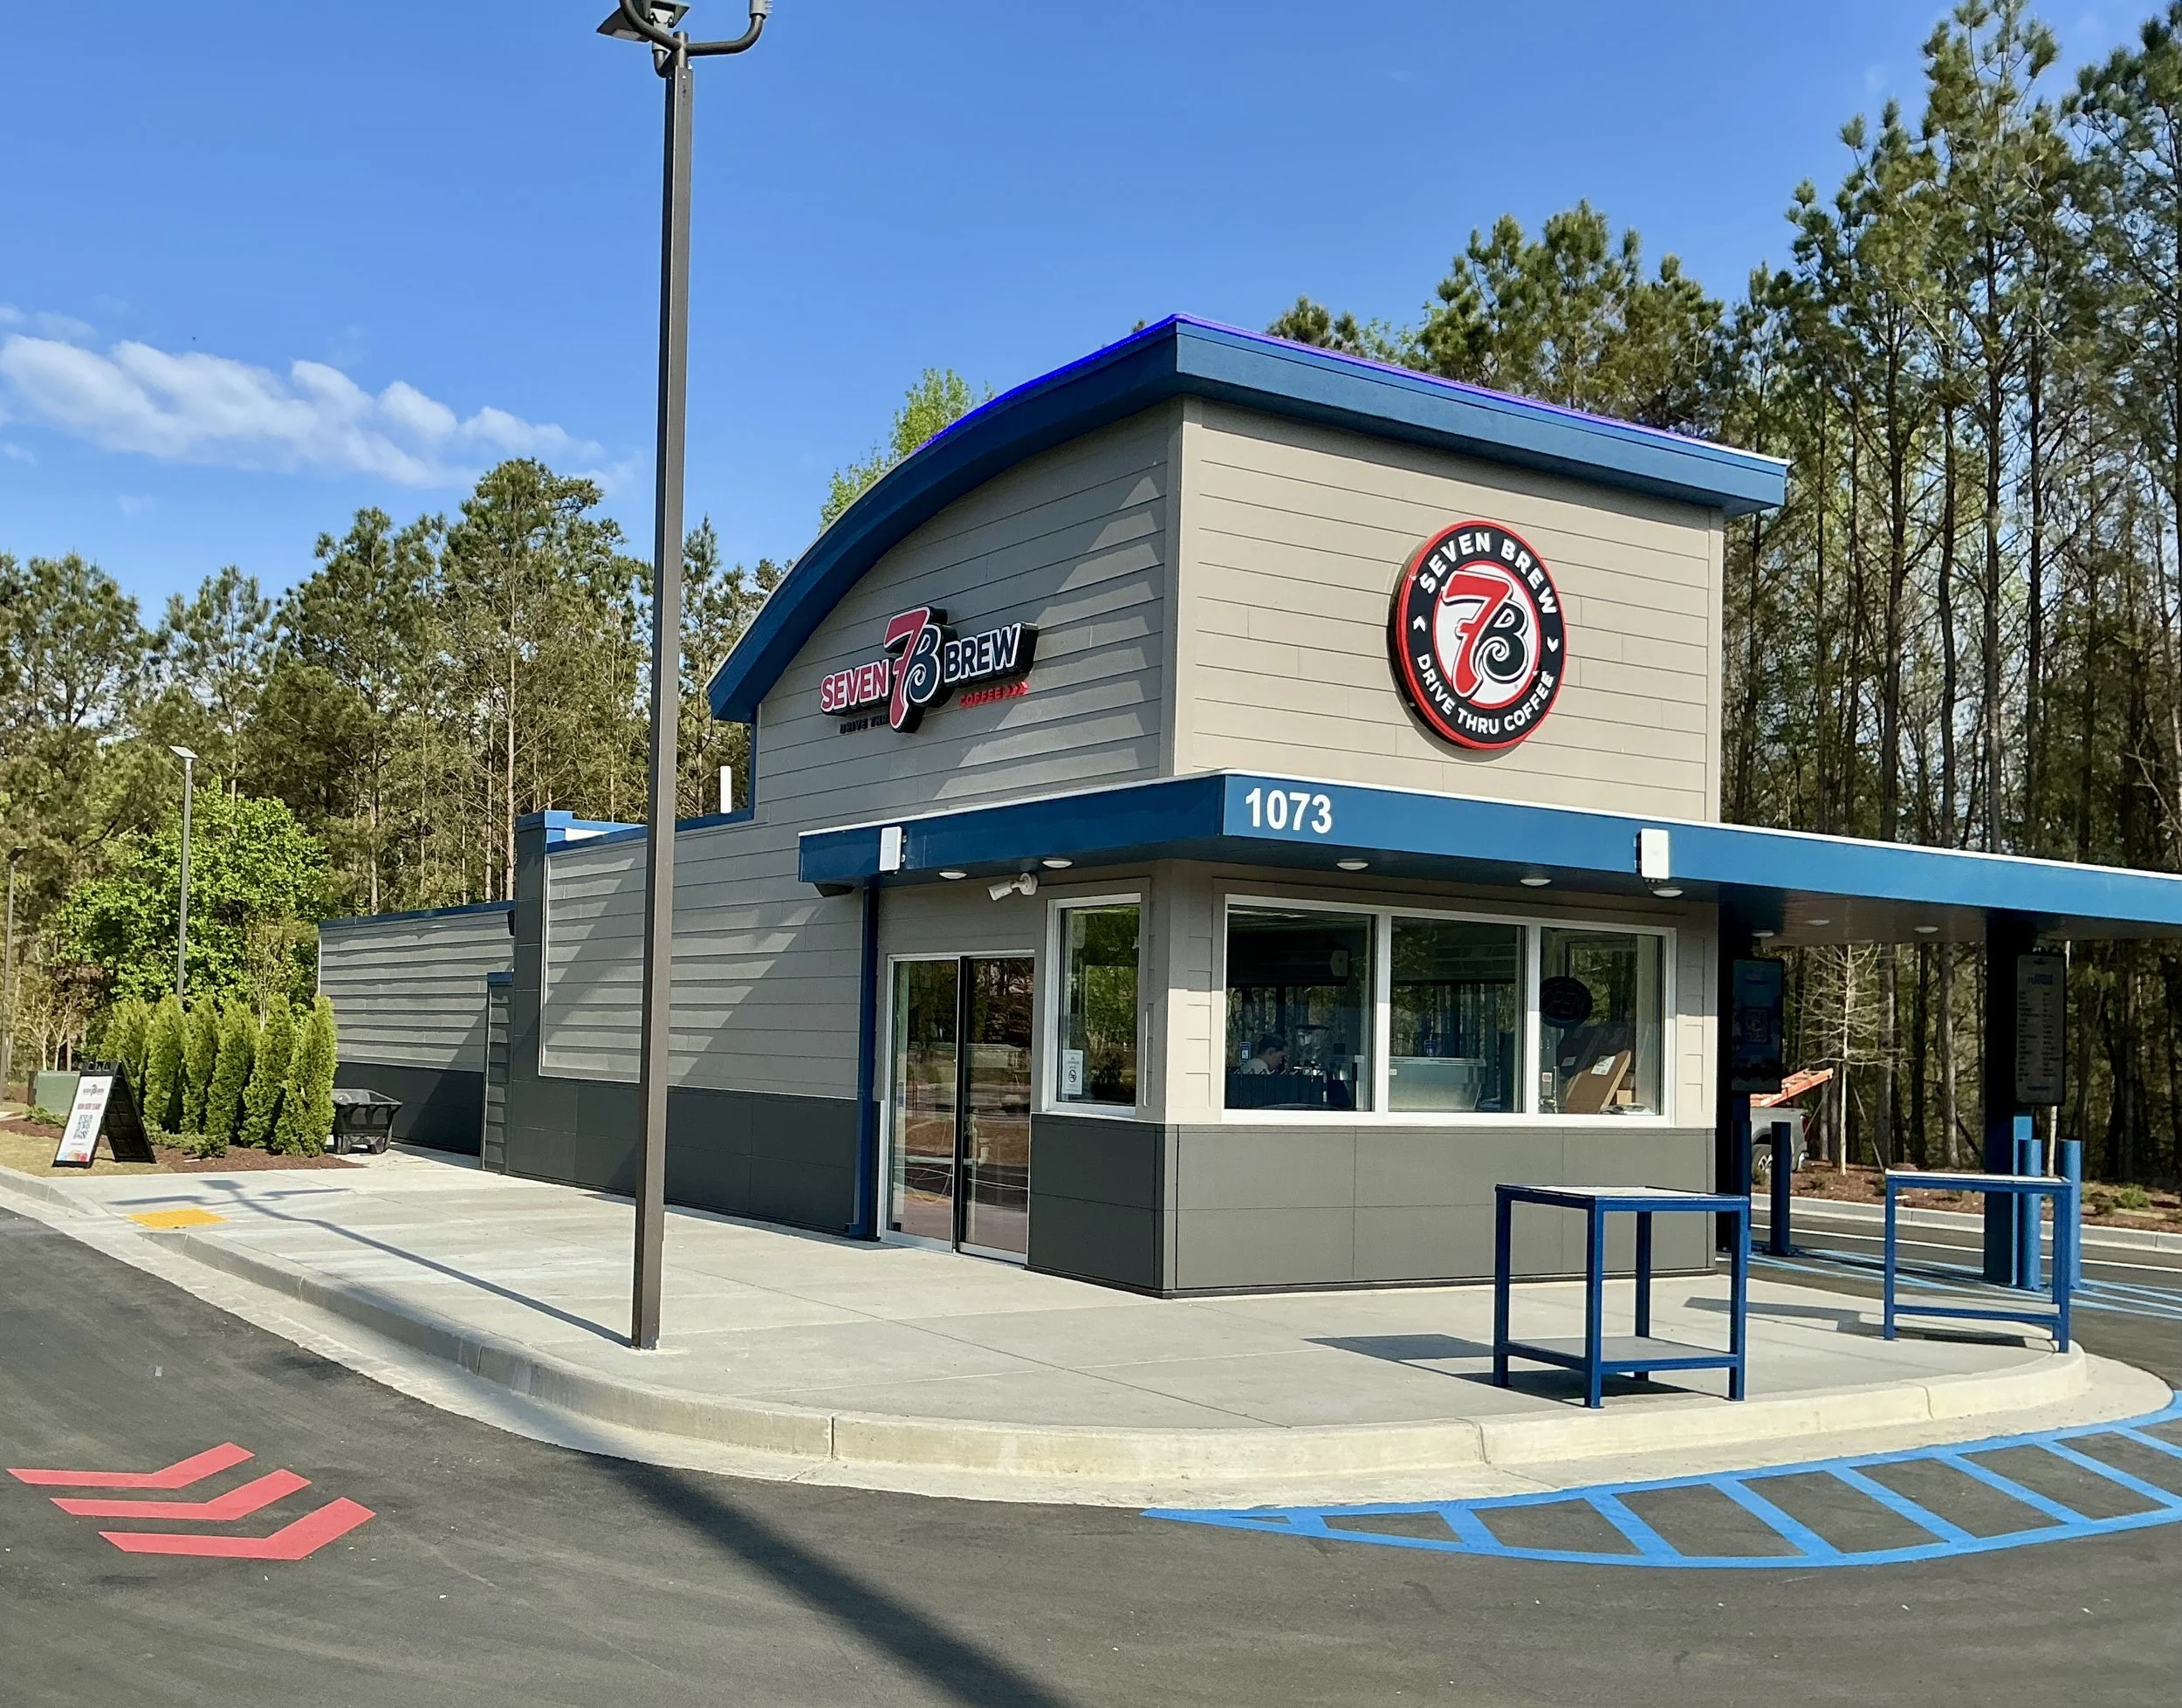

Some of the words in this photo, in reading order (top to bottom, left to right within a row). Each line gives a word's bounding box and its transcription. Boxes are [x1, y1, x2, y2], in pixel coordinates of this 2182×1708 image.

[1419, 532, 1491, 593] SEVEN
[1499, 538, 1558, 614] BREW
[820, 659, 889, 713] SEVEN
[943, 622, 1022, 683] BREW
[1417, 652, 1456, 716] DRIVE
[1455, 707, 1500, 735] THRU
[1503, 669, 1554, 731] COFFEE
[840, 718, 868, 734] DRIVE
[959, 687, 1004, 708] COFFEE
[1245, 787, 1332, 834] 1073
[1540, 988, 1587, 1019] OPEN
